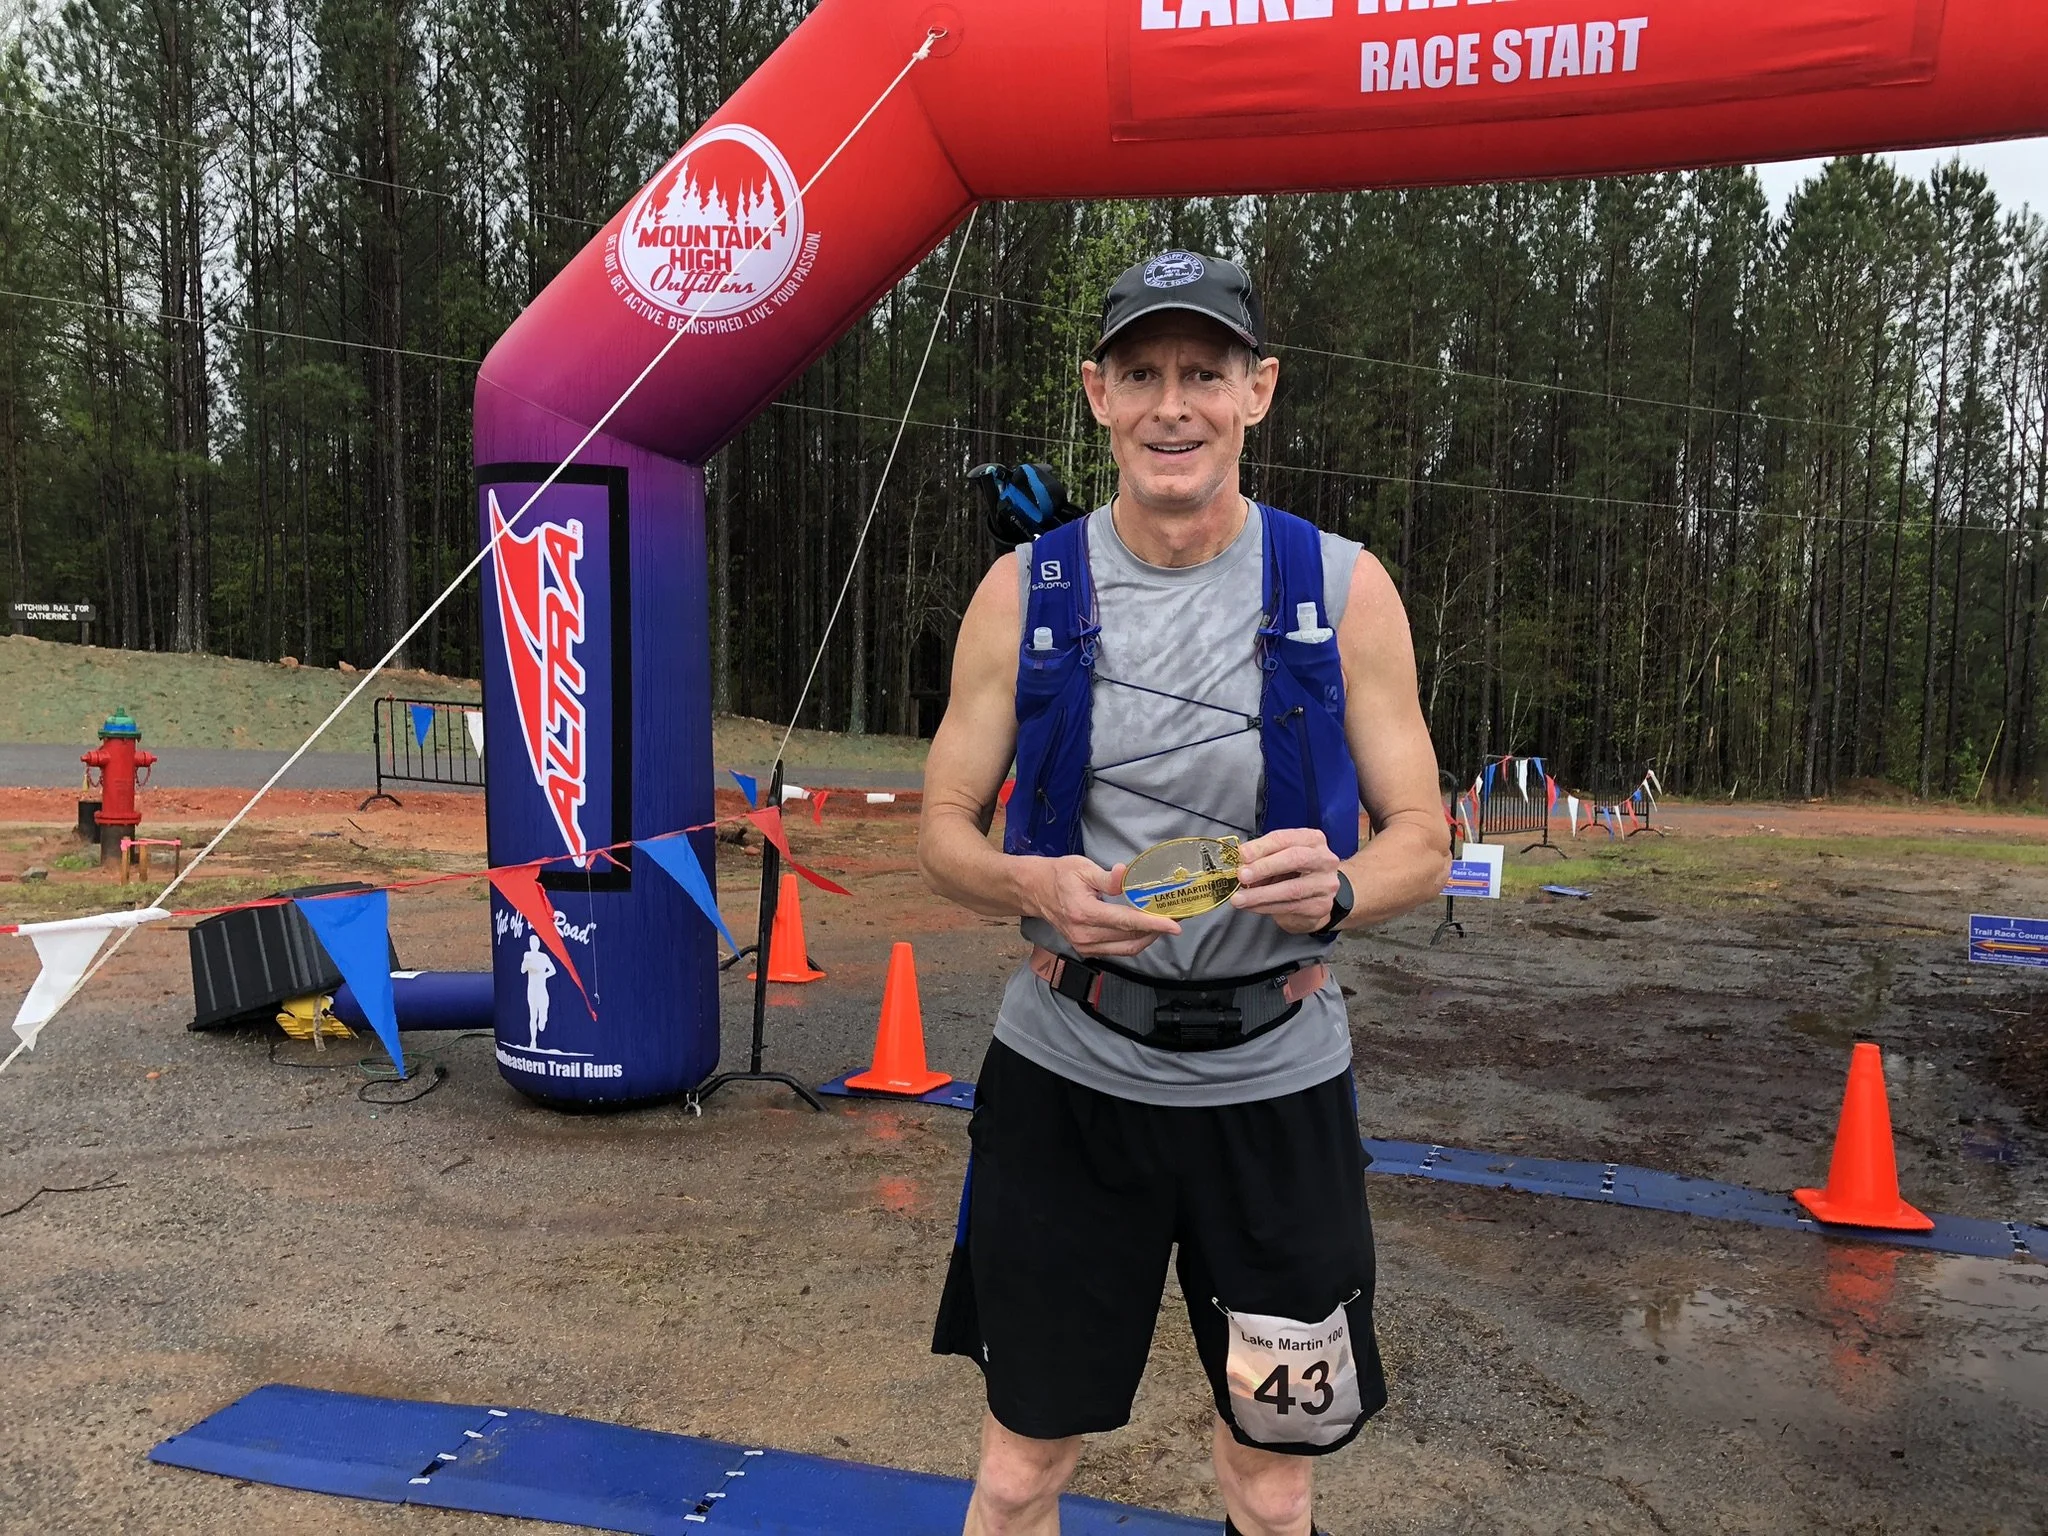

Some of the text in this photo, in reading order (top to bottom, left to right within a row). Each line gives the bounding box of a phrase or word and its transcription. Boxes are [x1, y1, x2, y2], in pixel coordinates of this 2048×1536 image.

[1360, 16, 1649, 93] RACE START
[605, 233, 618, 253] GET
[638, 224, 771, 250] MOUNTAIN
[670, 248, 732, 272] HIGH
[796, 231, 822, 283] PASSION.
[610, 274, 630, 296] GET
[650, 264, 757, 306] Outfitters
[770, 280, 800, 307] YOUR
[623, 292, 665, 327] ACTIVE.
[746, 301, 774, 326] LIVE
[667, 315, 684, 331] BE
[14, 603, 90, 613] HITCHING RAIL FOR
[543, 521, 587, 868] ALTRA
[1154, 891, 1176, 902] LAKE
[1177, 881, 1213, 898] MARTIN
[1973, 928, 1992, 936] Trail
[1994, 930, 2016, 938] Race
[547, 1060, 581, 1078] Trail
[583, 1062, 623, 1078] Runs
[1241, 1326, 1344, 1351] Lake Martin 100
[1253, 1360, 1335, 1416] 43
